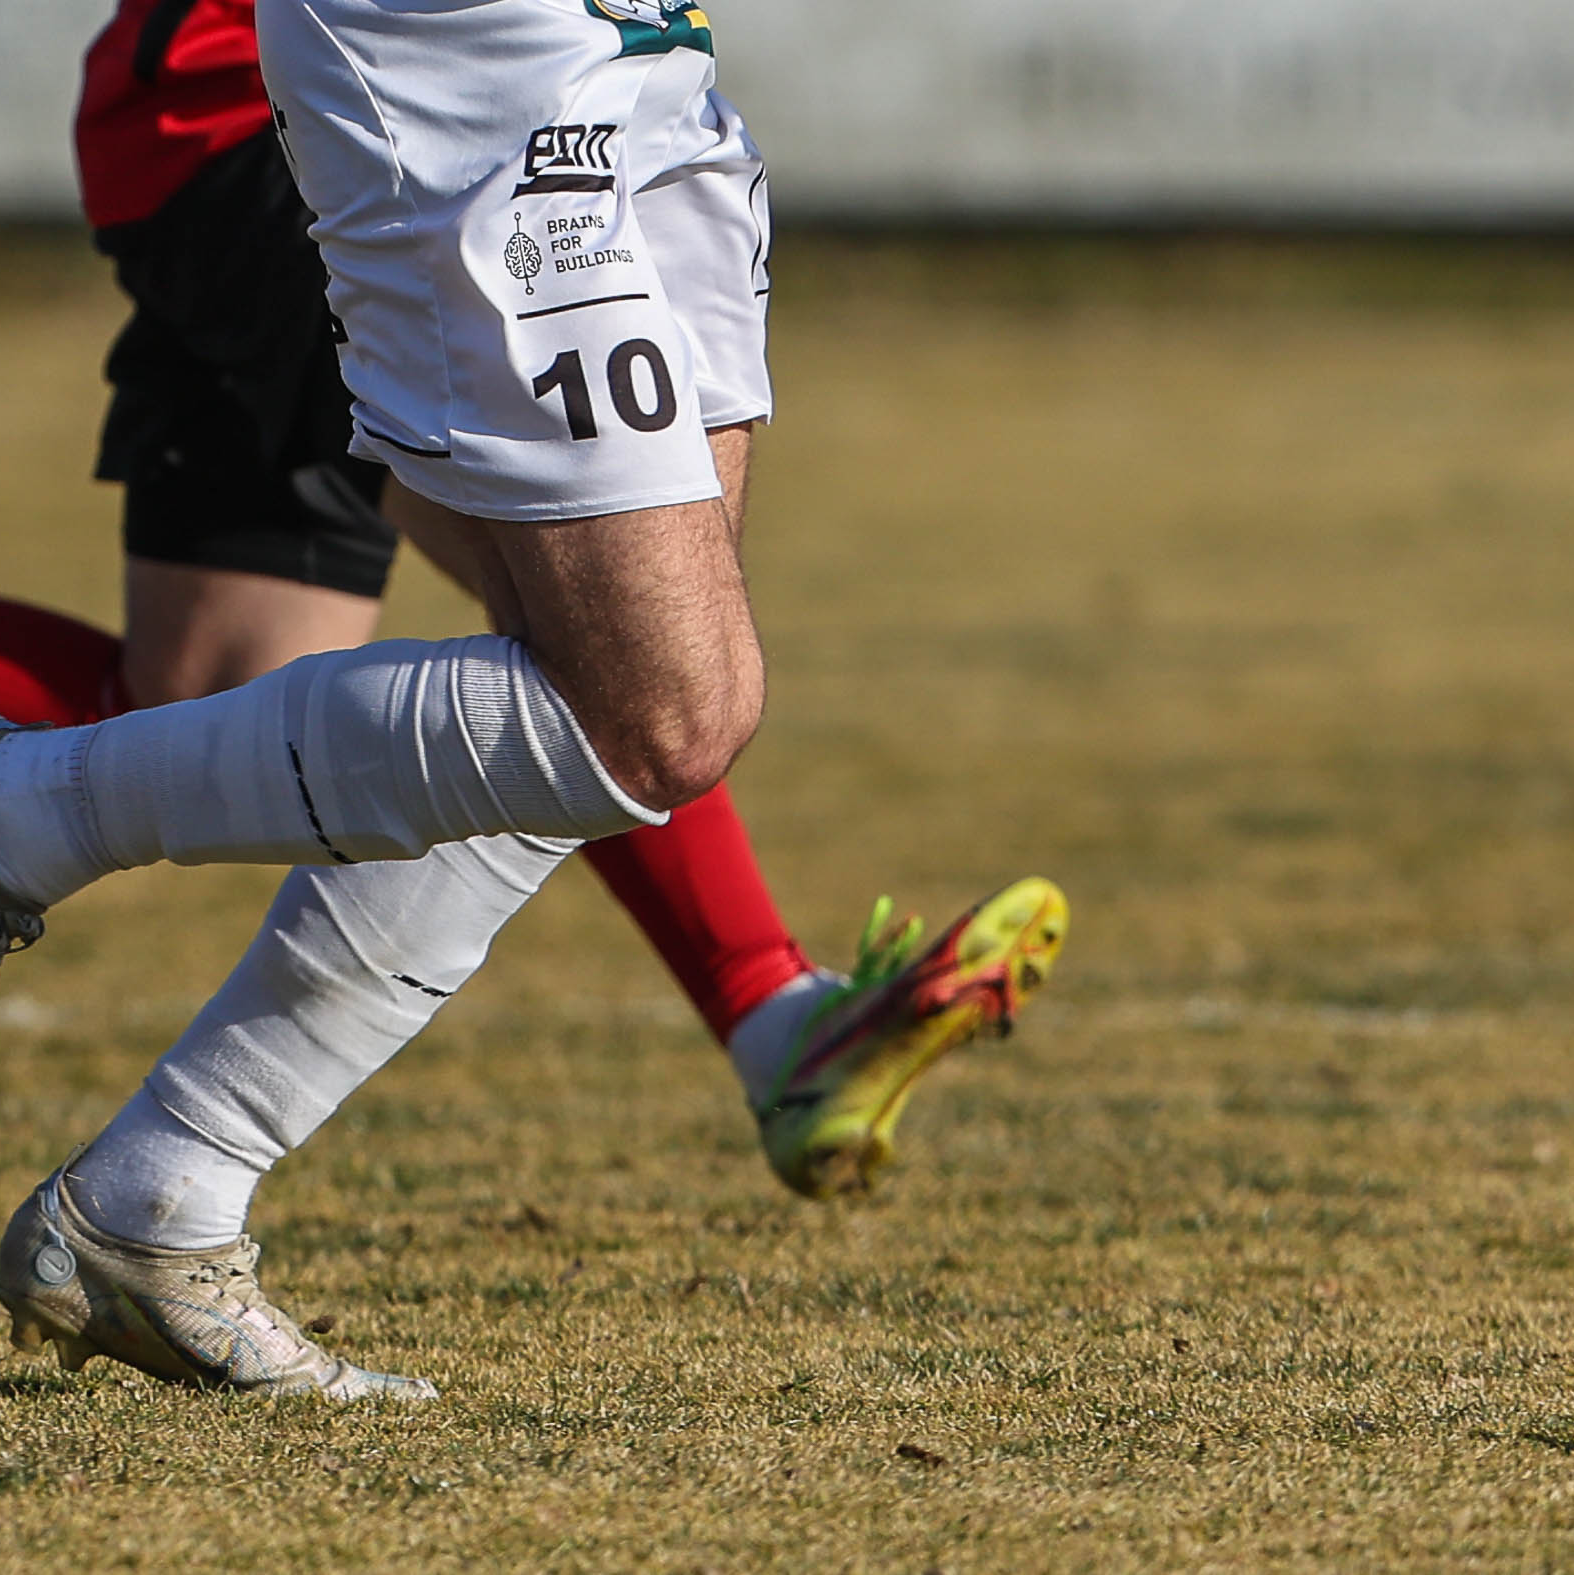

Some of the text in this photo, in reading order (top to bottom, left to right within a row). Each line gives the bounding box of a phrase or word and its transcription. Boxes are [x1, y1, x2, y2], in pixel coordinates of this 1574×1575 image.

[547, 215, 605, 234] BRAINS
[551, 235, 582, 253] FOR
[556, 249, 634, 273] BUILDINGS
[532, 338, 677, 442] 10
